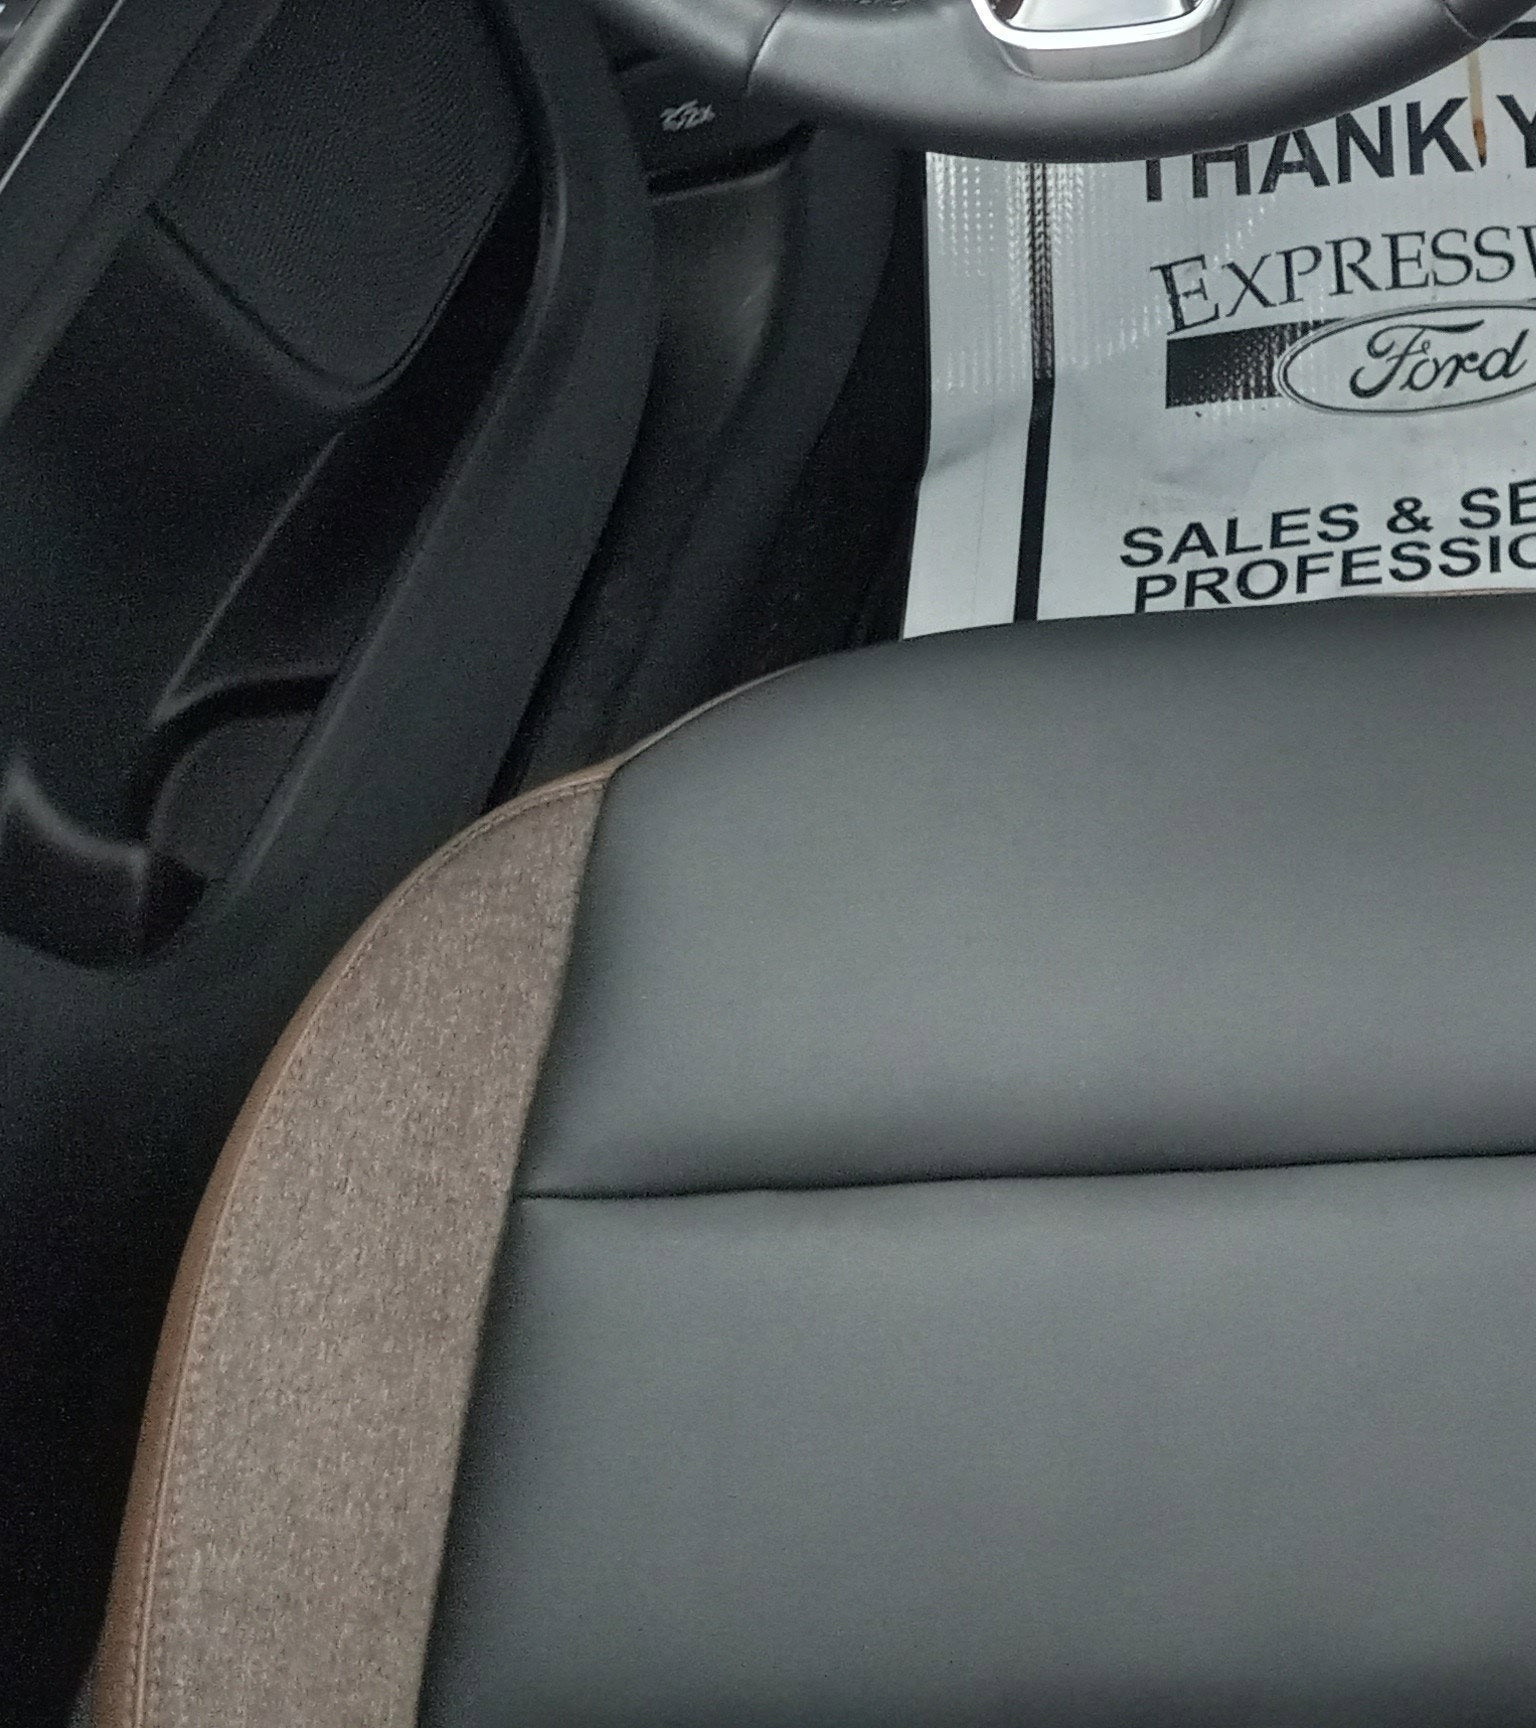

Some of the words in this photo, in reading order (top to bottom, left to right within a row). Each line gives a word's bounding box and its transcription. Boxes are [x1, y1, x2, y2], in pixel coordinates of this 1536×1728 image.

[1350, 318, 1532, 400] Ford
[1119, 501, 1360, 569] SALES
[1385, 496, 1434, 534] &
